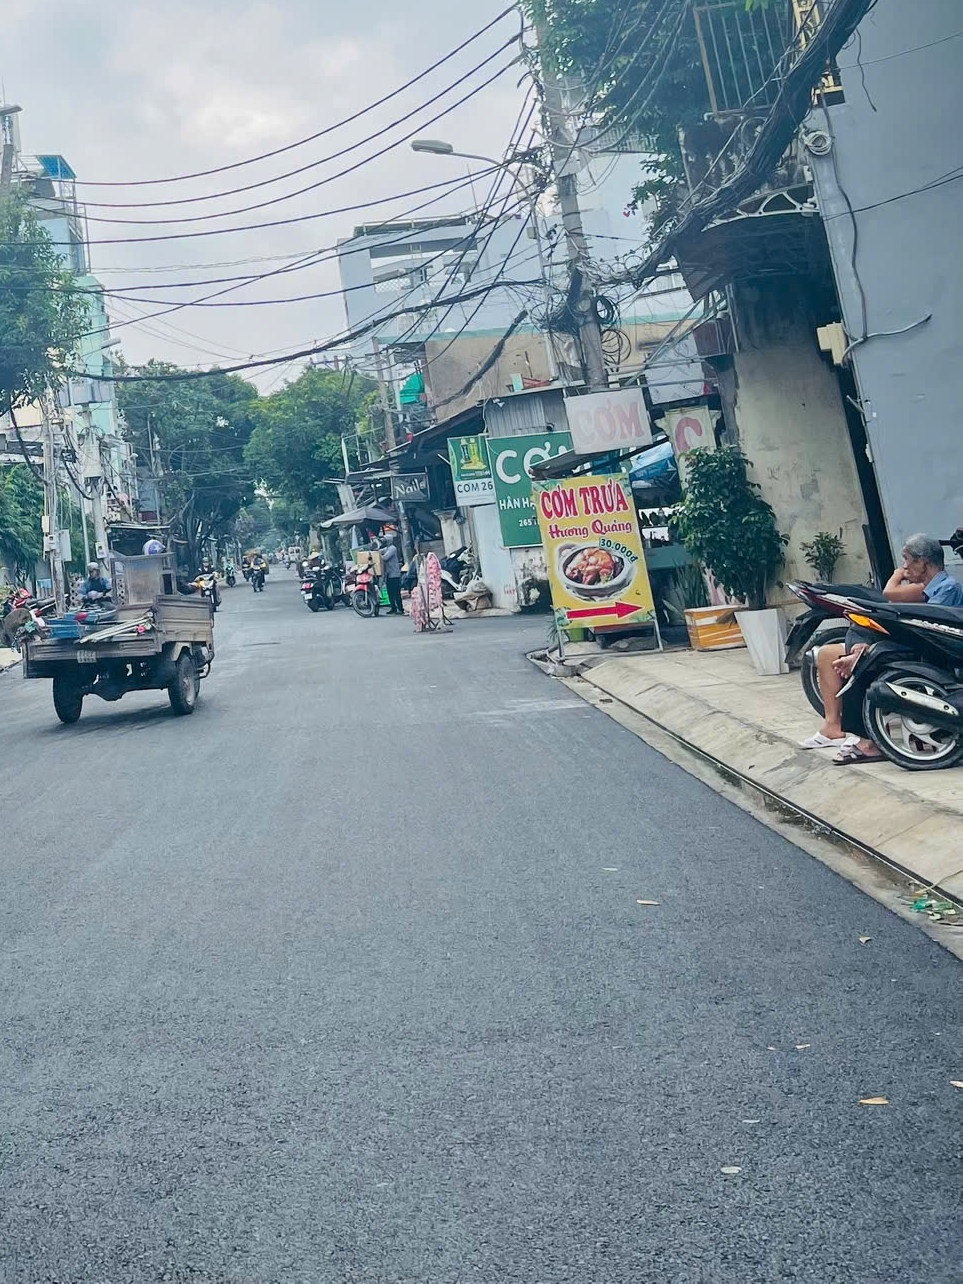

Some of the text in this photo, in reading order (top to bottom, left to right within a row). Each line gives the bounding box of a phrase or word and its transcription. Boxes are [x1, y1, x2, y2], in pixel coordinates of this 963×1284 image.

[499, 496, 522, 510] HÂN
[541, 479, 629, 519] CƠM TRƯA
[549, 524, 589, 539] Hương
